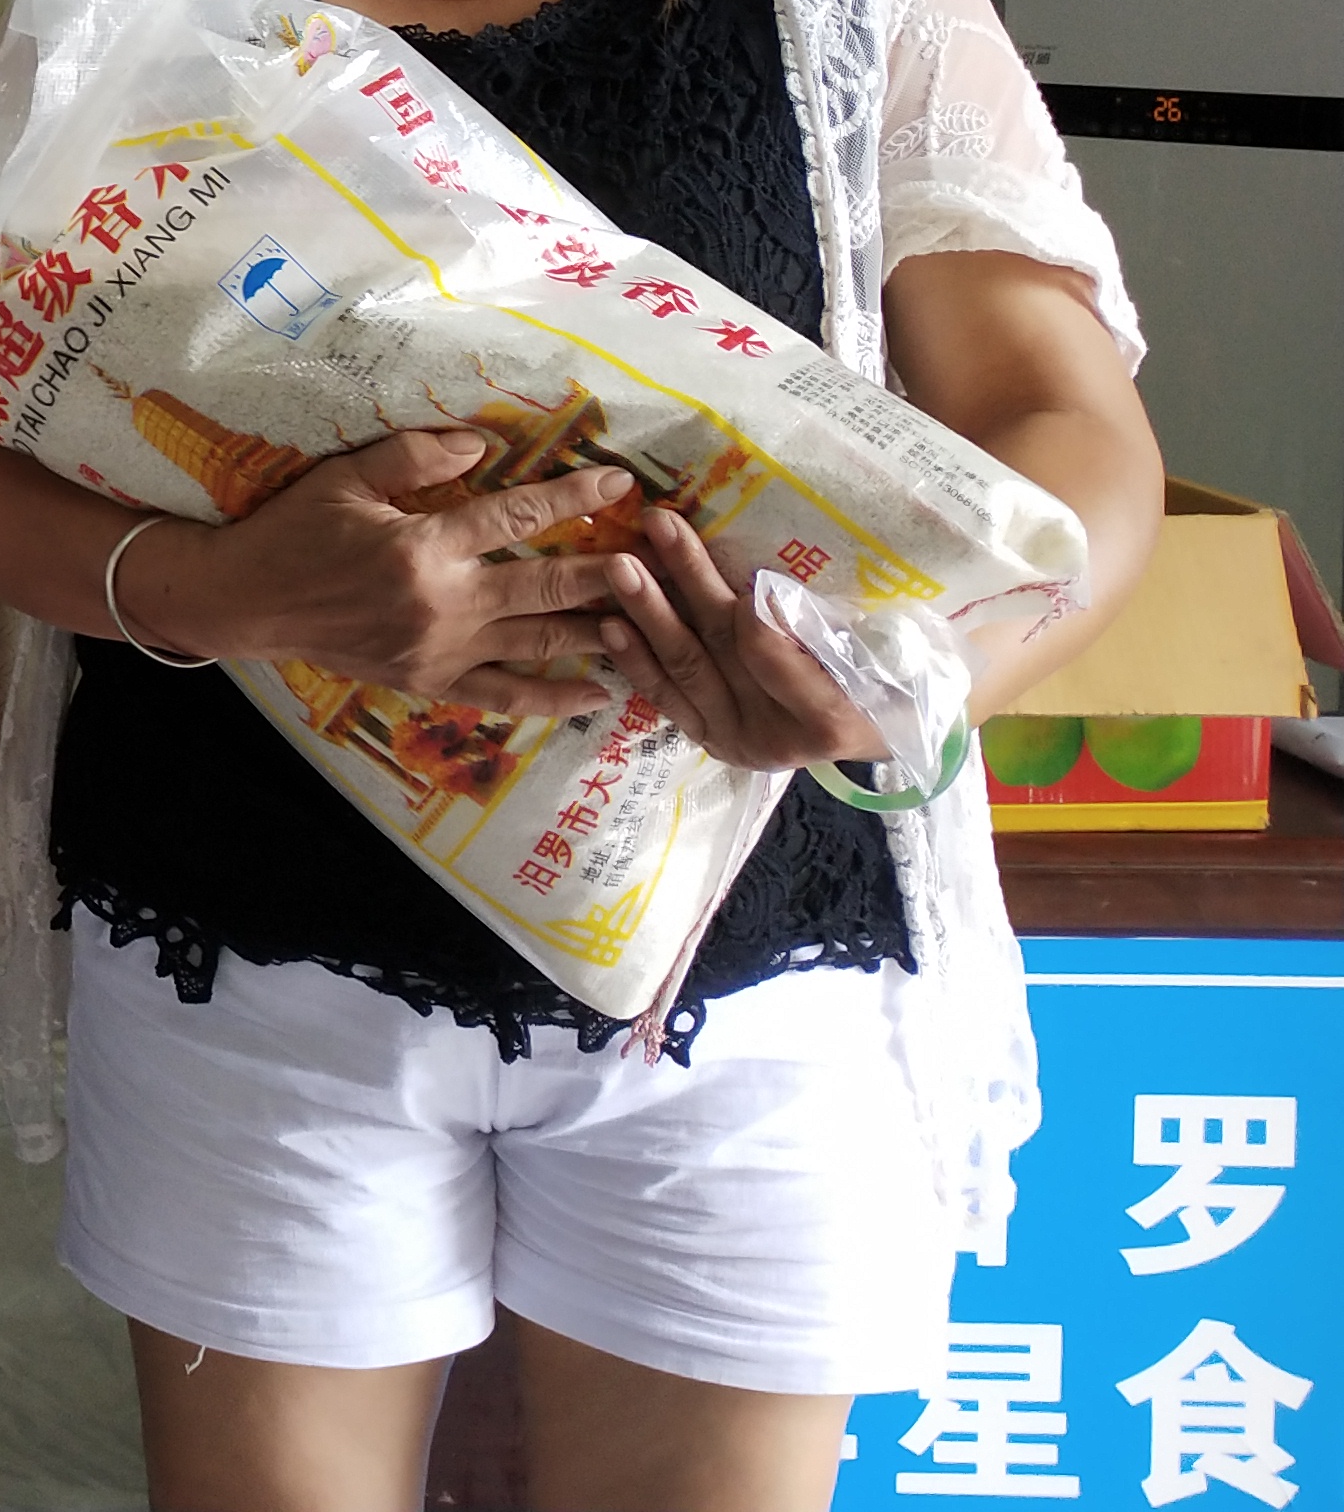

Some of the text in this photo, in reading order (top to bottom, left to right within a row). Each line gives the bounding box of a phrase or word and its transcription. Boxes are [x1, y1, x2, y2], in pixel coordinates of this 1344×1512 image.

[1154, 97, 1182, 122] 26
[188, 164, 231, 208] MI
[105, 200, 196, 300] XIANG
[83, 297, 114, 329] JI
[29, 324, 91, 406] CHAO
[16, 405, 48, 442] TAI
[777, 537, 832, 583] 品
